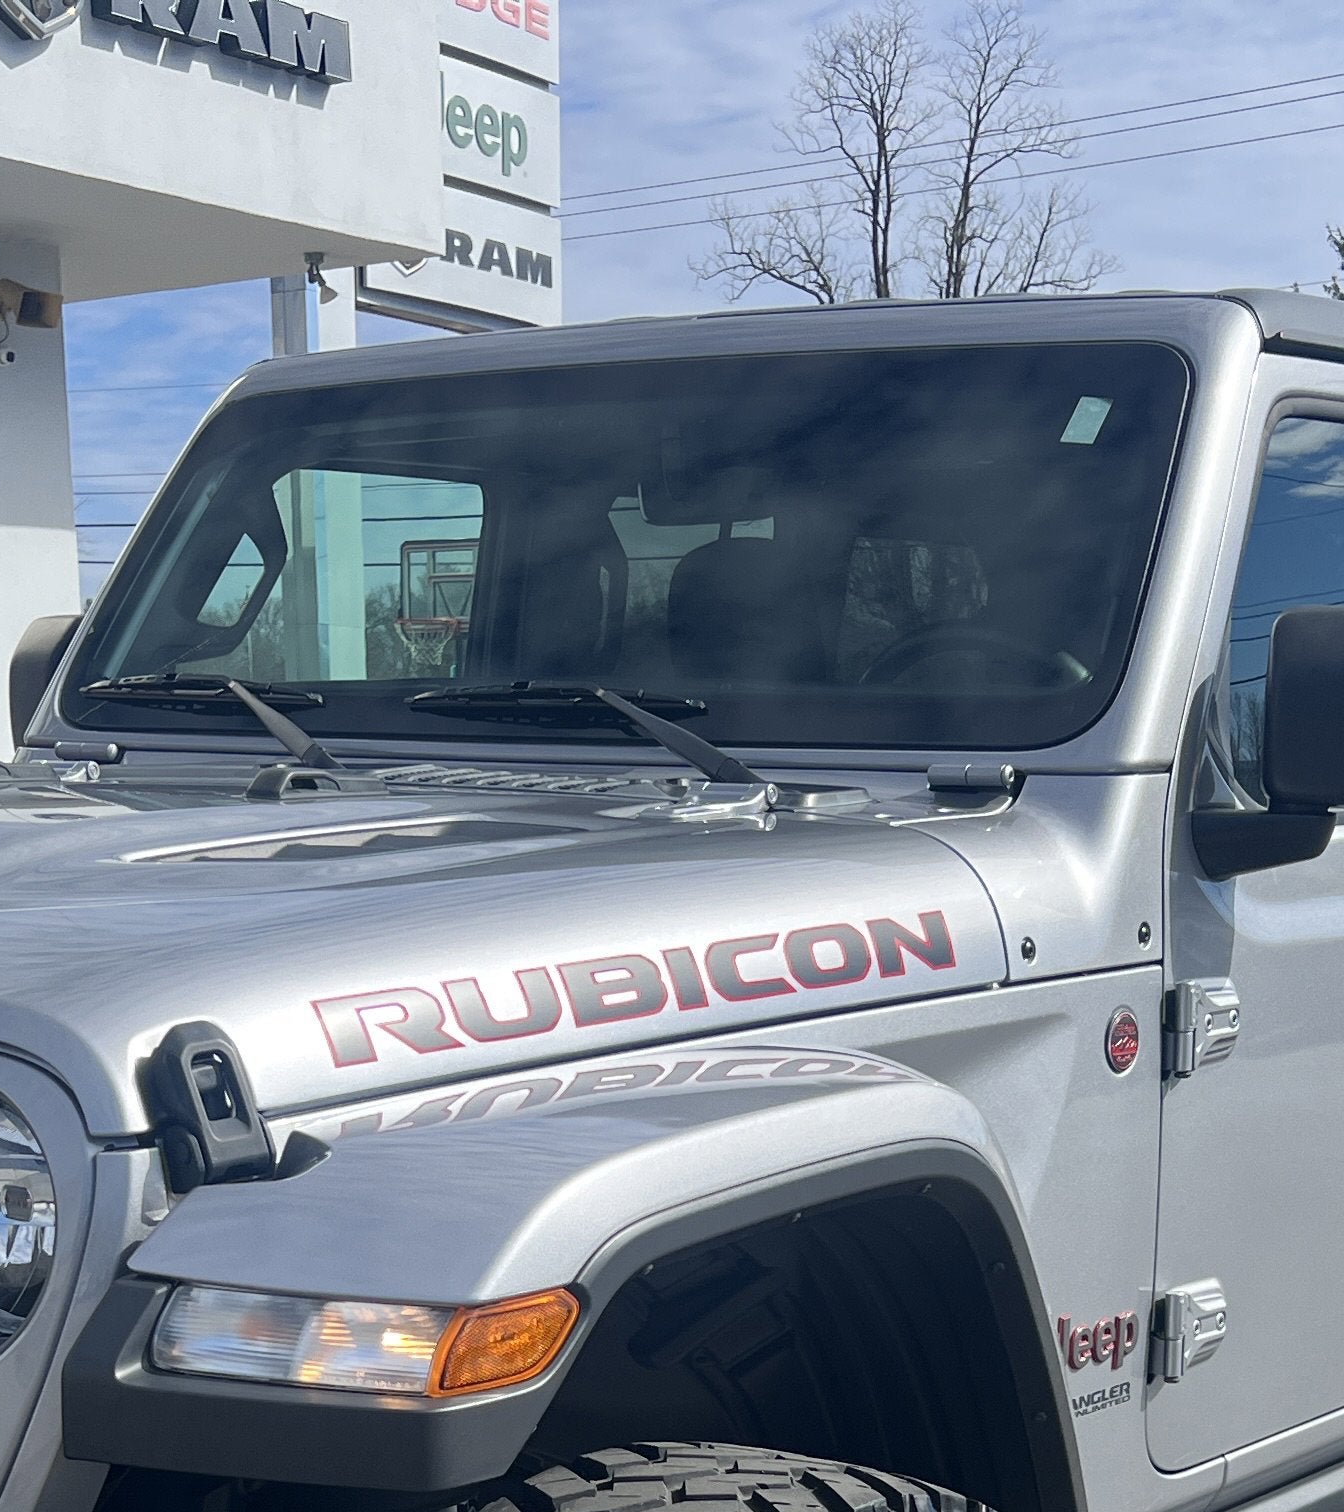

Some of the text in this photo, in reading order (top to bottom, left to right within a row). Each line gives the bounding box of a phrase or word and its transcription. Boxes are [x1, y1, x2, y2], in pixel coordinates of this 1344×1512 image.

[441, 72, 528, 176] eep
[440, 228, 553, 289] RAM
[311, 910, 957, 1068] RUBICON
[1074, 1395, 1131, 1418] NLIMITED
